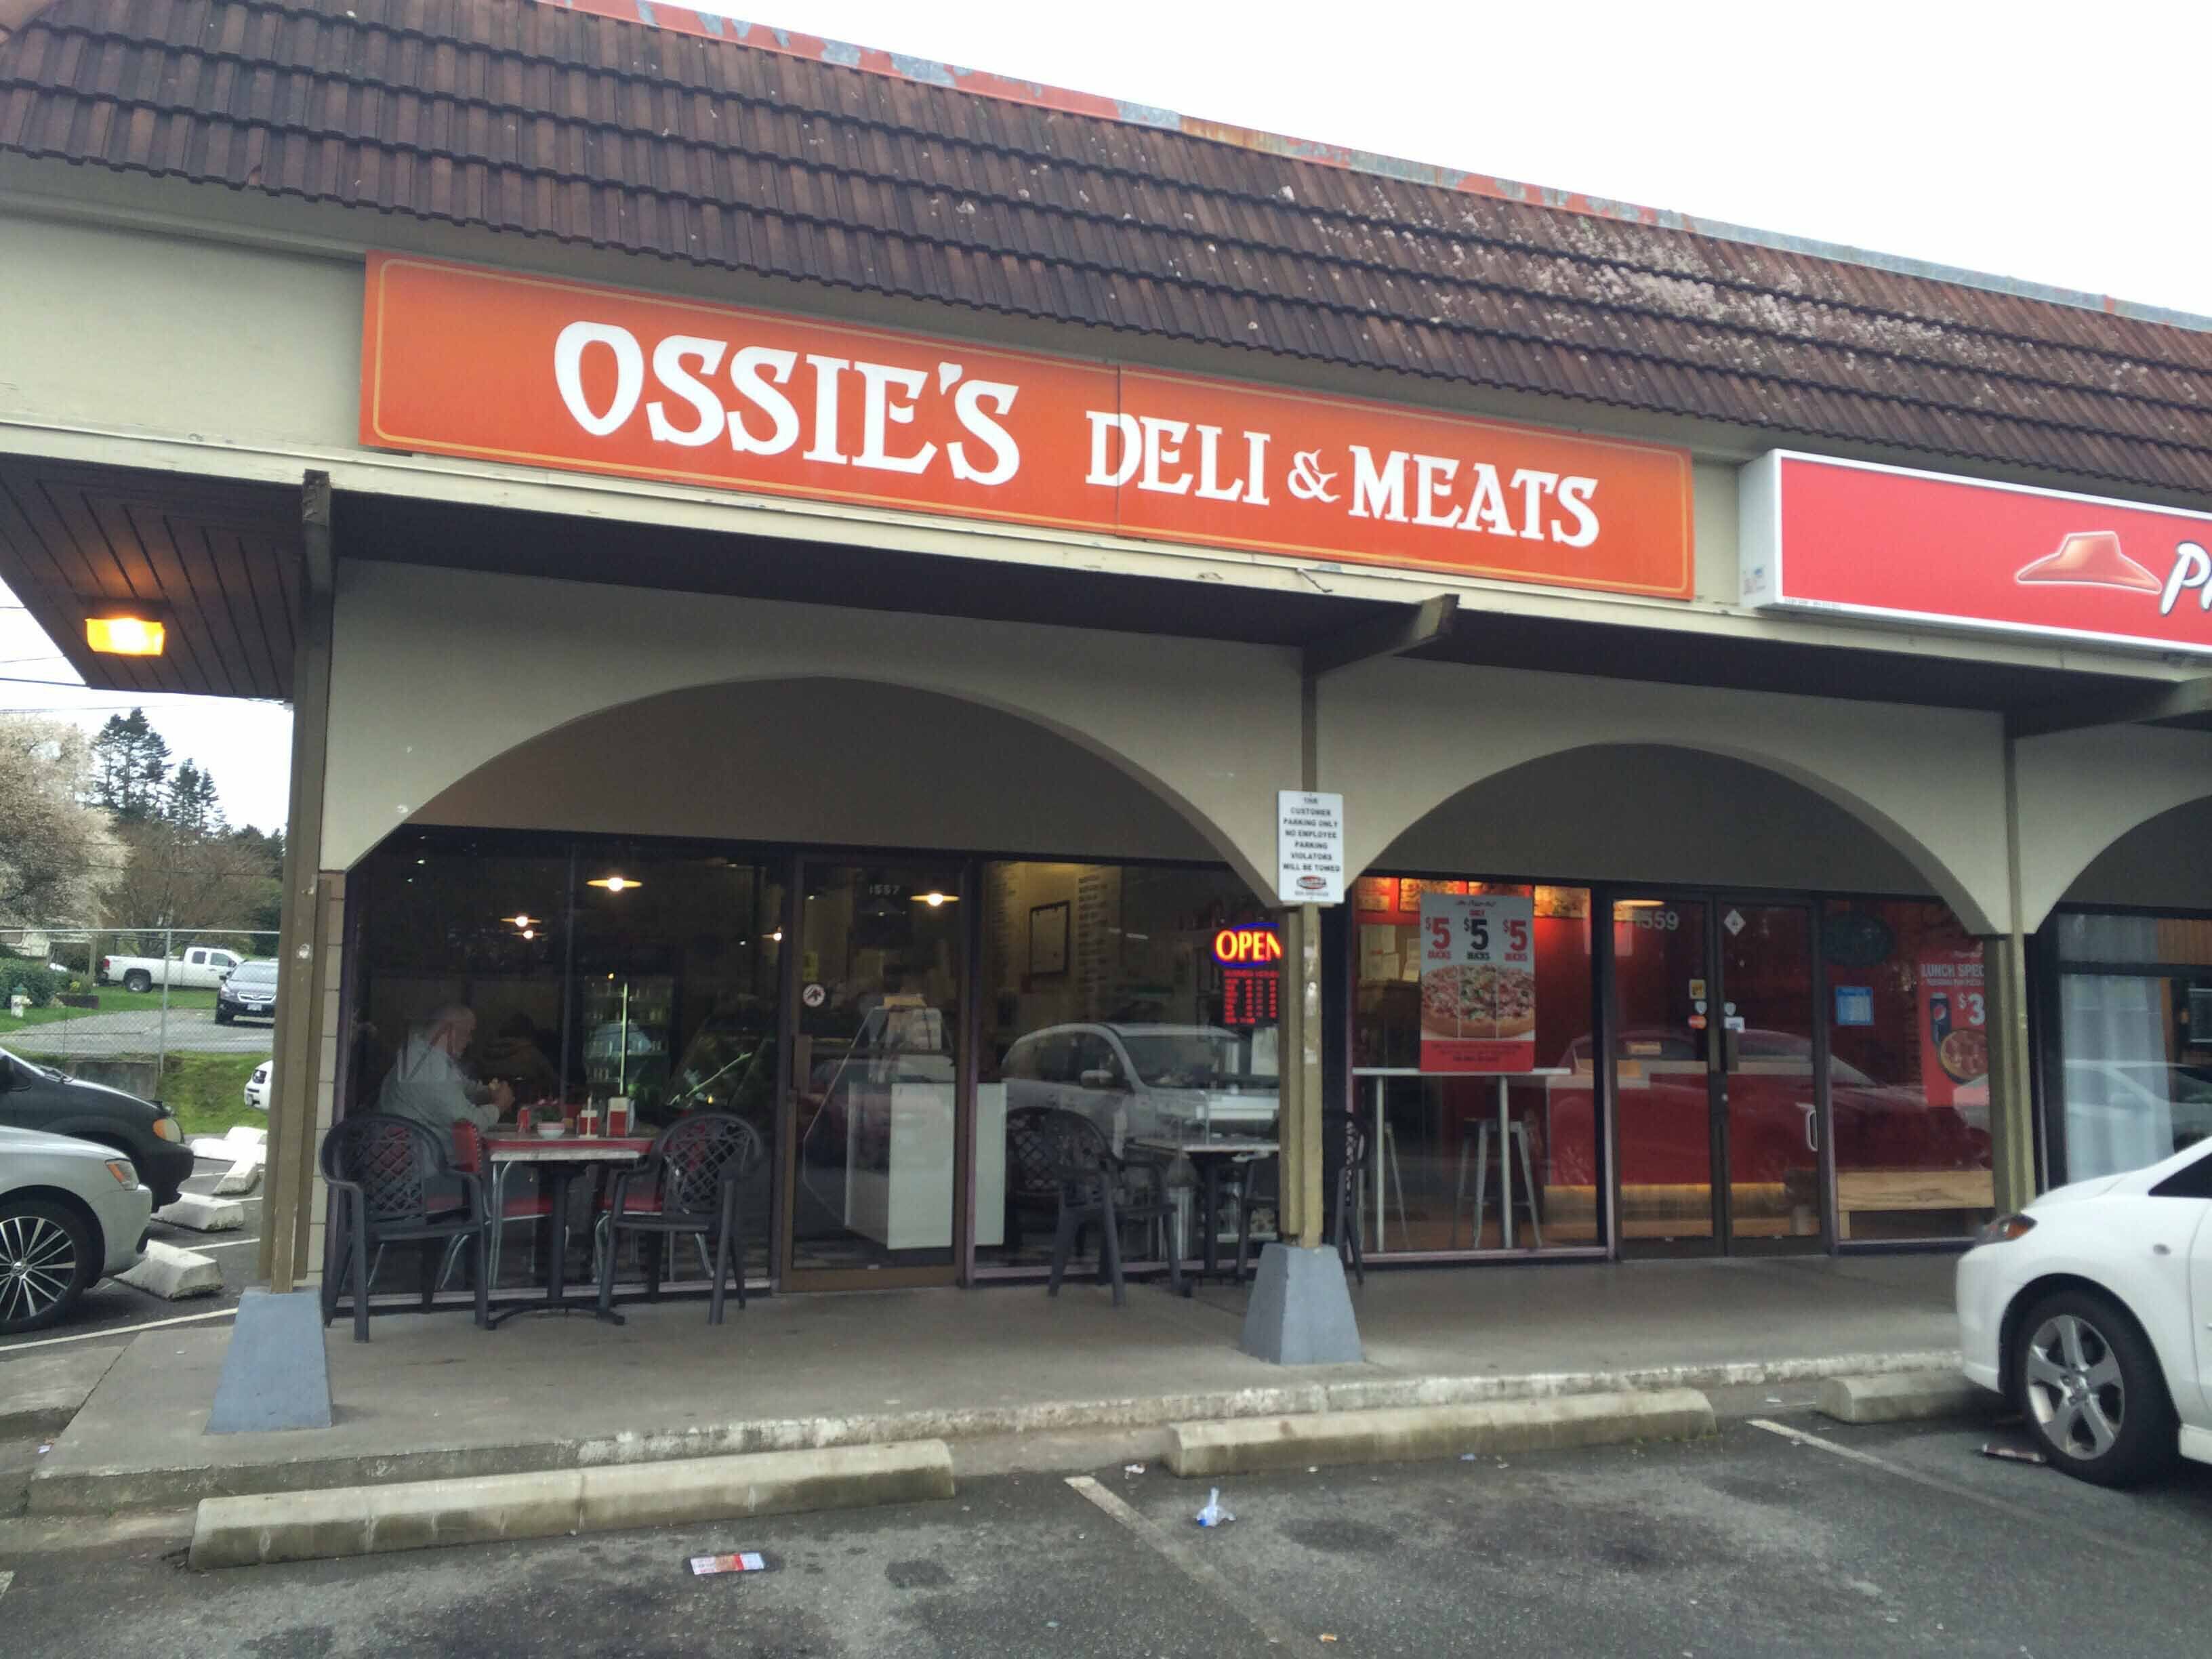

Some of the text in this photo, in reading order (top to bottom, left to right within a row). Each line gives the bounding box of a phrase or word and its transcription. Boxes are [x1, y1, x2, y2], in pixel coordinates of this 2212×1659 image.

[554, 321, 1600, 548] OSSIE'S DELI & MEATS
[1290, 807, 1331, 816] CUSTOMER
[1283, 818, 1338, 827] PARKING ONLY
[1298, 830, 1337, 839] EMPLOYEE
[1294, 841, 1328, 849] PARKING
[1290, 852, 1332, 861] VIOLATORS
[1283, 863, 1300, 871] WILL
[1425, 917, 1528, 951] $5 $5 $5
[1921, 964, 1955, 977] LUNCH
